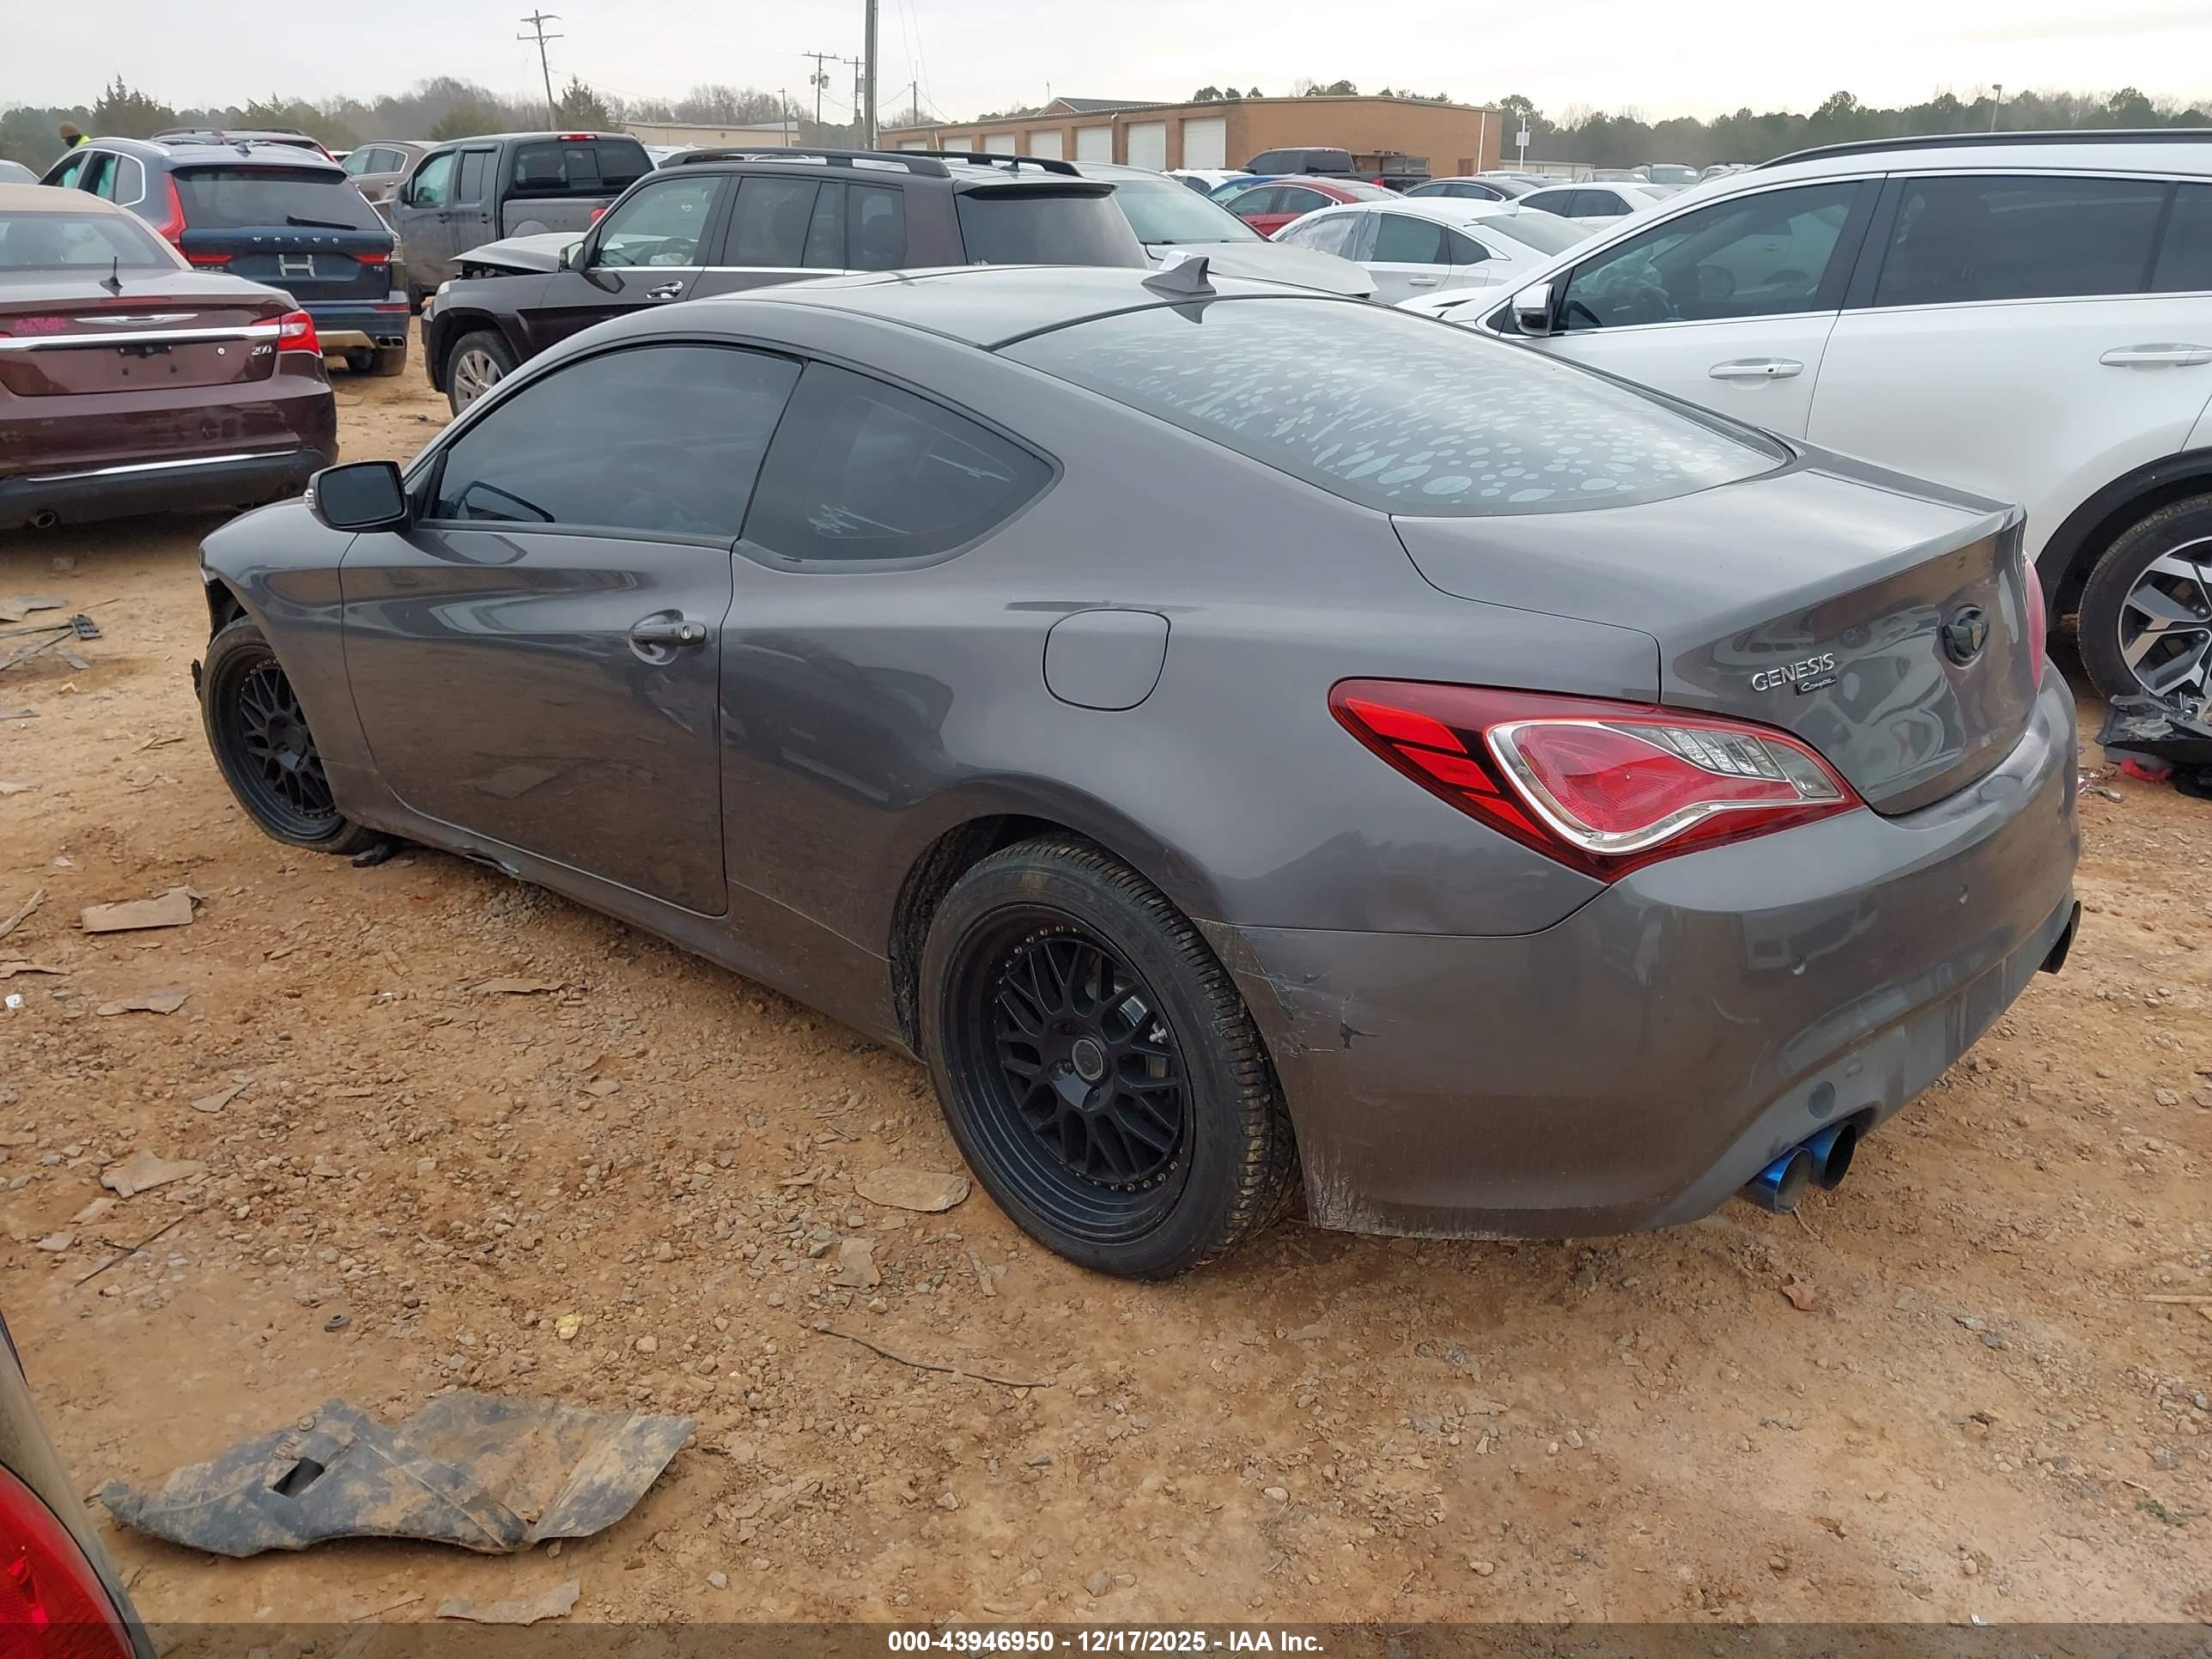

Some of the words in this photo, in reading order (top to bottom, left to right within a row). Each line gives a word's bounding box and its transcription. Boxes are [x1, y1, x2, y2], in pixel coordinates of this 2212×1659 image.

[252, 236, 339, 245] VOLVO
[251, 344, 272, 356] 200
[1752, 653, 1835, 691] GENESIS
[1801, 678, 1837, 692] Coupe
